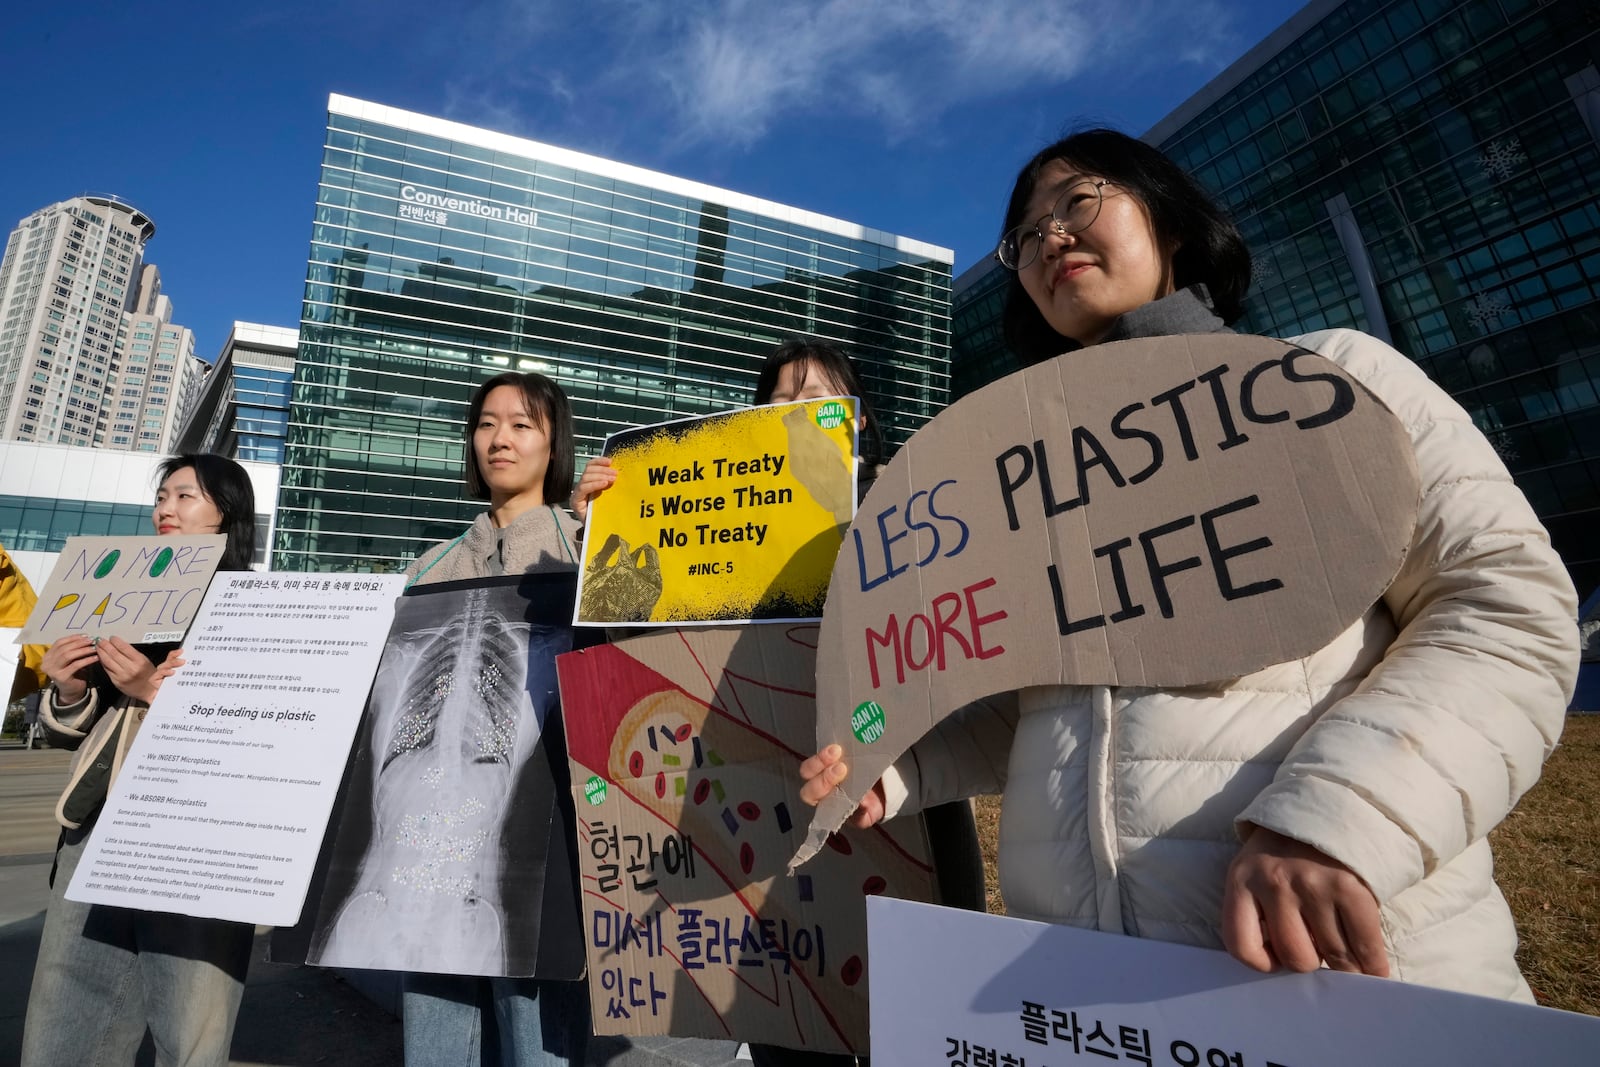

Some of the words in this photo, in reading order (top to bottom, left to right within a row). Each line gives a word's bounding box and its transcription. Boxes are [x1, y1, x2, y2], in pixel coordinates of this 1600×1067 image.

[399, 204, 448, 225] 컨벤션홀
[401, 186, 502, 218] Convention
[505, 206, 538, 226] Hall
[818, 404, 835, 417] BAN
[835, 403, 844, 415] IT
[821, 417, 842, 429] NOW
[648, 460, 704, 486] Weak
[713, 453, 785, 478] Treaty
[853, 480, 969, 592] LESS
[996, 349, 1356, 531] PLASTICS
[640, 500, 655, 518] is
[661, 494, 725, 516] Worse
[733, 485, 793, 508] Than
[658, 528, 688, 548] No
[696, 522, 768, 546] Treaty
[63, 548, 121, 582] NO
[122, 546, 216, 579] MORE
[688, 561, 734, 576] #INC-5
[230, 579, 280, 589] 미세플라스틱,
[282, 580, 300, 590] 이미
[302, 580, 320, 590] 우리
[322, 580, 331, 590] 몸
[333, 580, 351, 590] 속에
[353, 581, 383, 591] 있어요!
[865, 577, 1008, 688] MORE
[1047, 495, 1285, 635] LIFE
[40, 588, 201, 631] PLASTIC
[190, 704, 214, 716] Stop
[217, 705, 258, 720] feeding
[260, 709, 276, 718] us
[276, 708, 316, 722] plastic
[850, 706, 871, 732] BAN
[868, 701, 880, 717] IT
[171, 723, 194, 732] INHALE
[194, 726, 233, 735] Microplastics
[861, 718, 884, 744] NOW
[158, 753, 180, 762] INGEST
[180, 756, 220, 766] Microplastics
[140, 793, 165, 803] ABSORB
[166, 796, 206, 807] Microplastics
[584, 780, 598, 795] BAN
[590, 788, 606, 806] NOW
[590, 821, 695, 893] 혈관에
[593, 910, 662, 957] 미세
[677, 909, 825, 977] 플라스틱이
[601, 967, 667, 1019] 있다
[1020, 1000, 1152, 1067] 플라스틱
